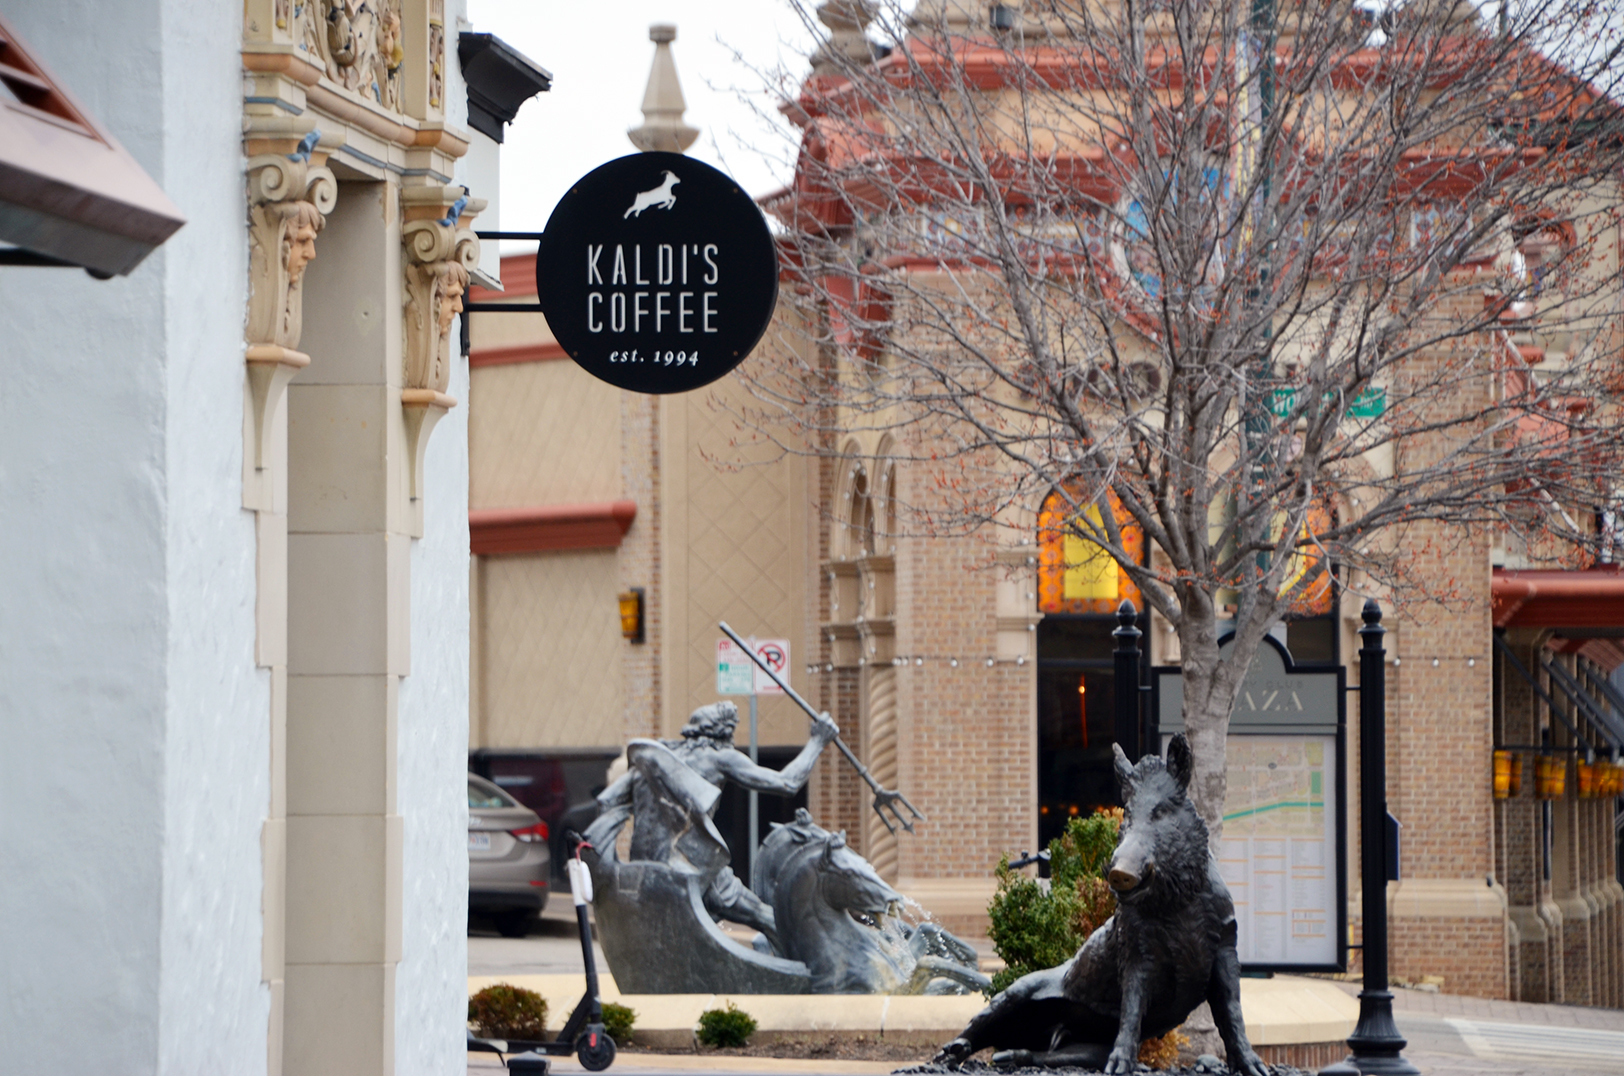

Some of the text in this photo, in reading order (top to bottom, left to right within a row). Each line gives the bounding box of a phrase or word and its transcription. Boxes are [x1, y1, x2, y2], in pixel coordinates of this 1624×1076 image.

[588, 243, 719, 285] KALDI'S
[588, 291, 718, 333] COFFEE
[609, 349, 700, 367] est. 1994
[1237, 689, 1304, 712] AZA
